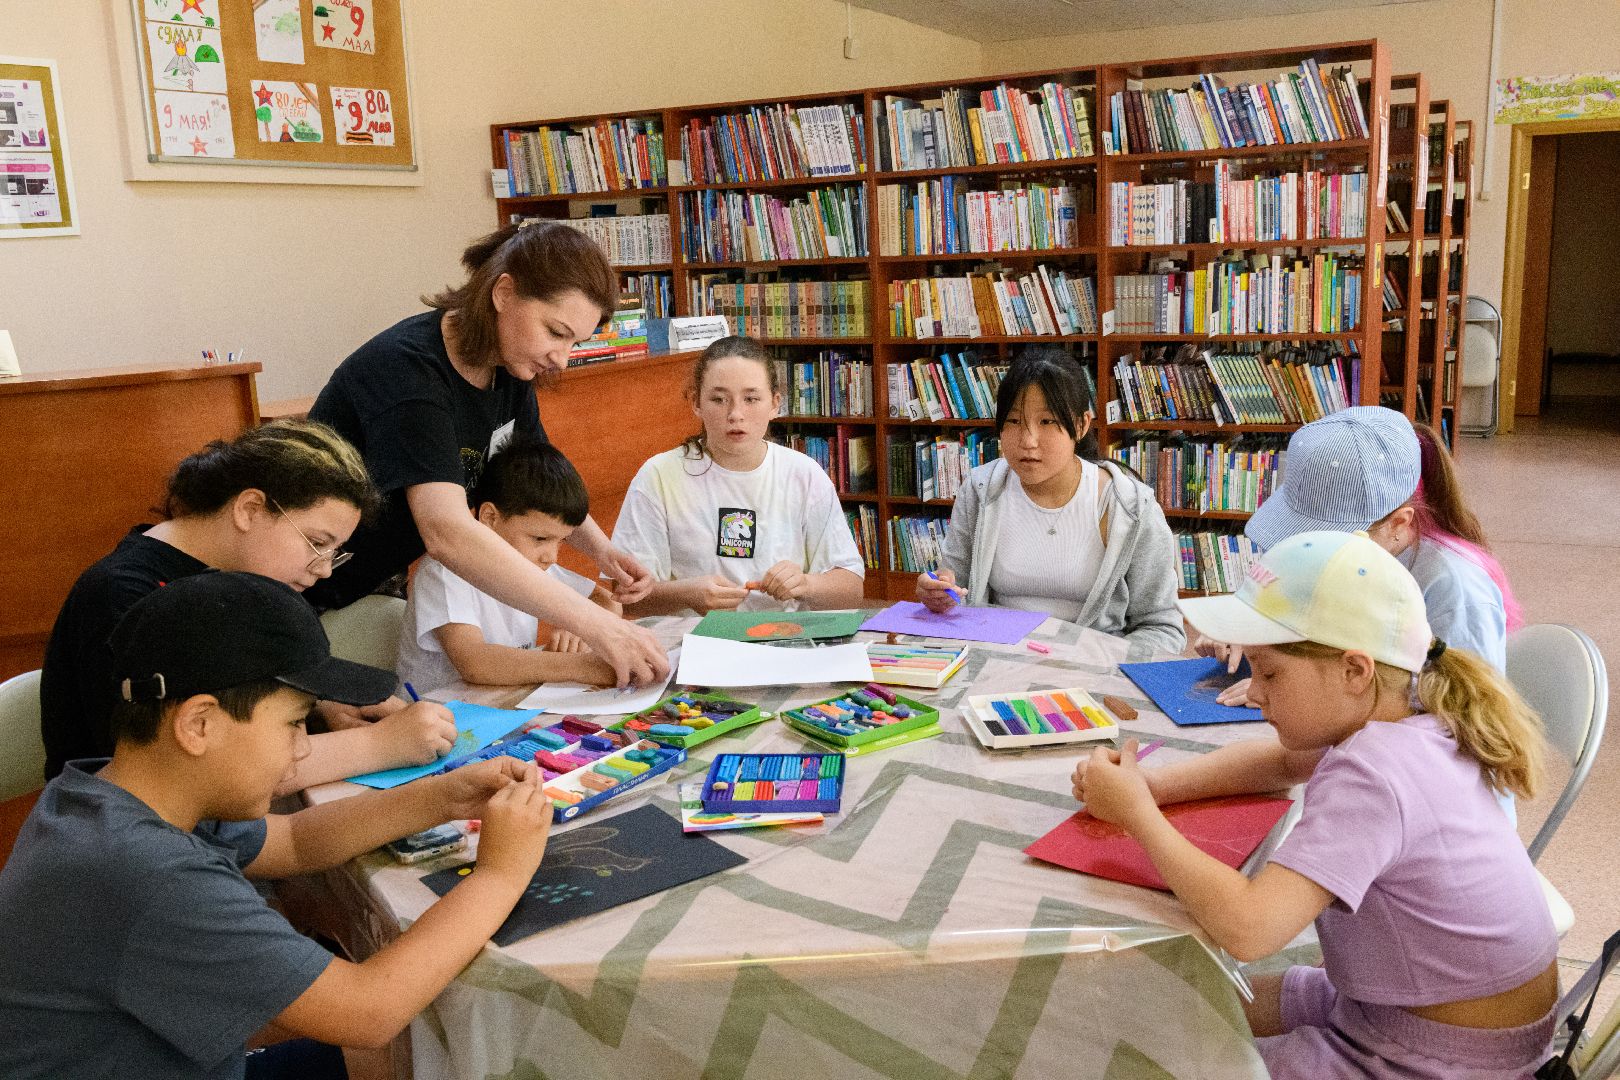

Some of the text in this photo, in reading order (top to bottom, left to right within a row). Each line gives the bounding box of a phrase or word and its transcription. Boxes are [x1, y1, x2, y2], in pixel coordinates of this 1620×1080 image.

[350, 6, 365, 37] 9
[342, 36, 372, 52] МАЯ
[275, 91, 290, 109] 80
[163, 104, 212, 131] 9 МАЯ!
[347, 101, 364, 131] 9
[720, 537, 753, 549] UNICORN
